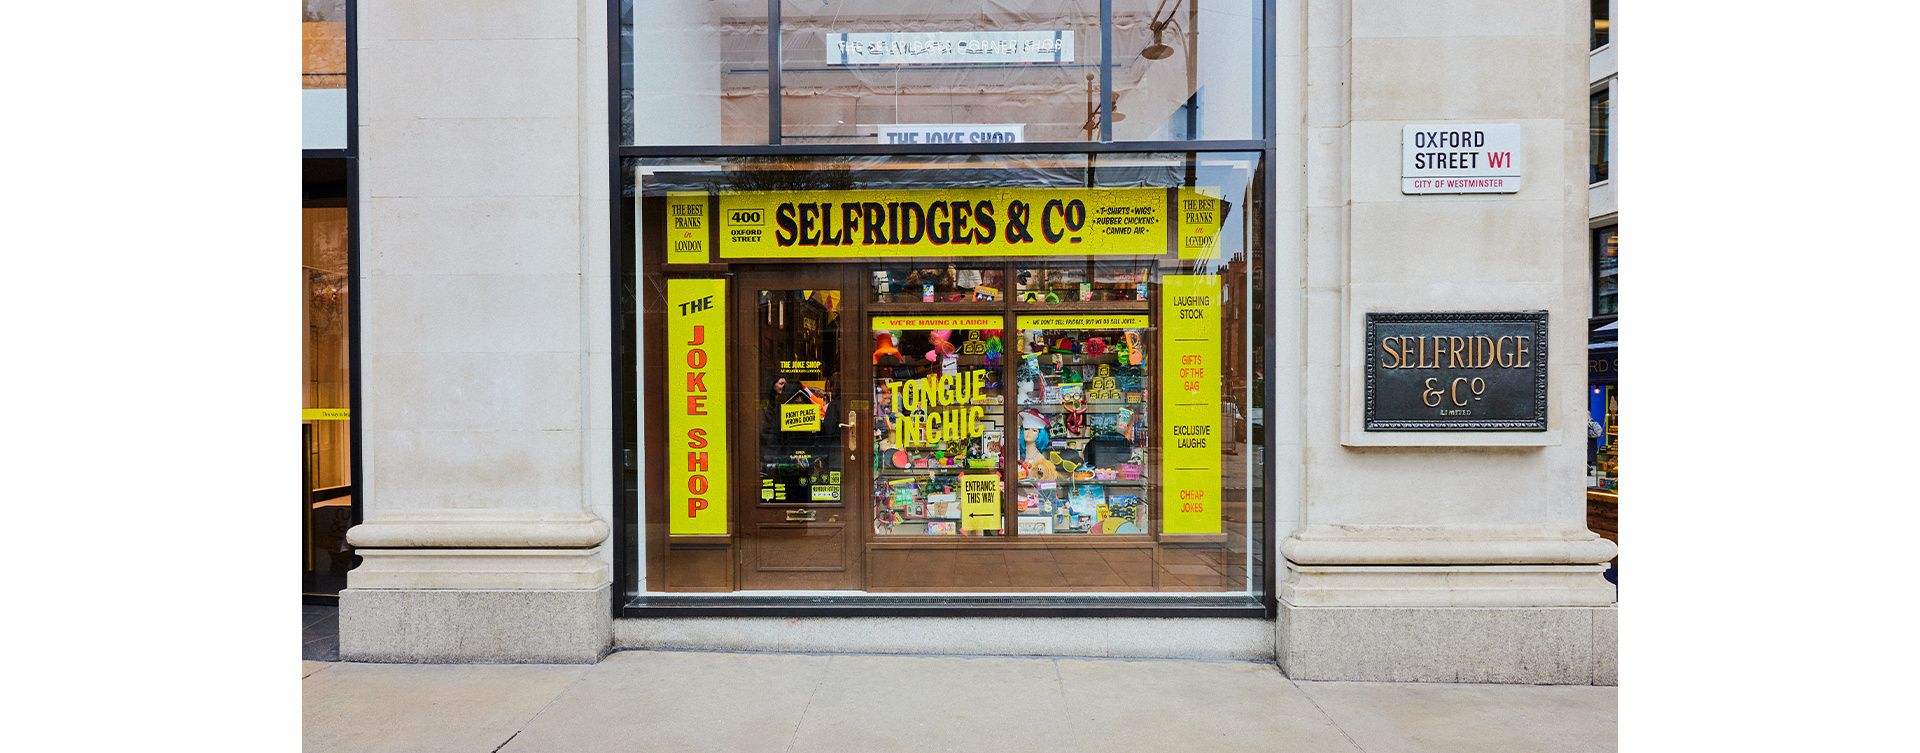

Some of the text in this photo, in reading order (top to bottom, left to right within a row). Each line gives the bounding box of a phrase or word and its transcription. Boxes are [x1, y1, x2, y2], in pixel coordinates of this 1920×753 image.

[838, 38, 1062, 56] THE SELFRIDGES CORNER SHOP
[1415, 131, 1485, 148] OXFORD
[1415, 151, 1511, 169] STREET W1
[1414, 179, 1503, 188] CITY OF WESTMINSTER
[672, 204, 703, 215] THE BEST
[1100, 206, 1151, 215] T-SHIRTS WIGS
[1183, 199, 1215, 210] THE BEST
[674, 216, 701, 228] PRANKS
[731, 211, 761, 223] 400
[1097, 216, 1155, 225] RUBBER CHICKENS
[1186, 212, 1213, 223] PRANKS
[775, 199, 997, 248] SELFRIDGES
[1004, 199, 1034, 245] &
[683, 231, 692, 239] in
[1106, 226, 1145, 235] CANNED AIR
[1194, 226, 1204, 234] in
[674, 240, 702, 251] LONDON
[1185, 236, 1213, 247] LONDON
[679, 295, 714, 316] THE
[1173, 295, 1210, 307] LAUGHING
[1179, 308, 1204, 320] STOCK
[1381, 335, 1531, 369] SELFRIDGE
[780, 361, 821, 369] THE JOKE SHOP
[1181, 354, 1202, 366] GIFTS
[687, 325, 708, 416] JOKE
[1179, 367, 1204, 379] OF THE
[887, 369, 987, 413] TONGUE
[1184, 380, 1200, 392] GAG
[1422, 377, 1445, 407] &
[802, 415, 816, 423] DOOR
[896, 405, 985, 449] IN CHIC
[1173, 424, 1211, 436] EXCLUSIVE
[1177, 437, 1207, 449] LAUGHS
[687, 427, 709, 518] SHOP
[965, 480, 996, 492] ENTRANCE
[966, 492, 995, 504] THIS WAY
[1180, 489, 1204, 501] CHEAP
[1181, 502, 1203, 514] JOKES
